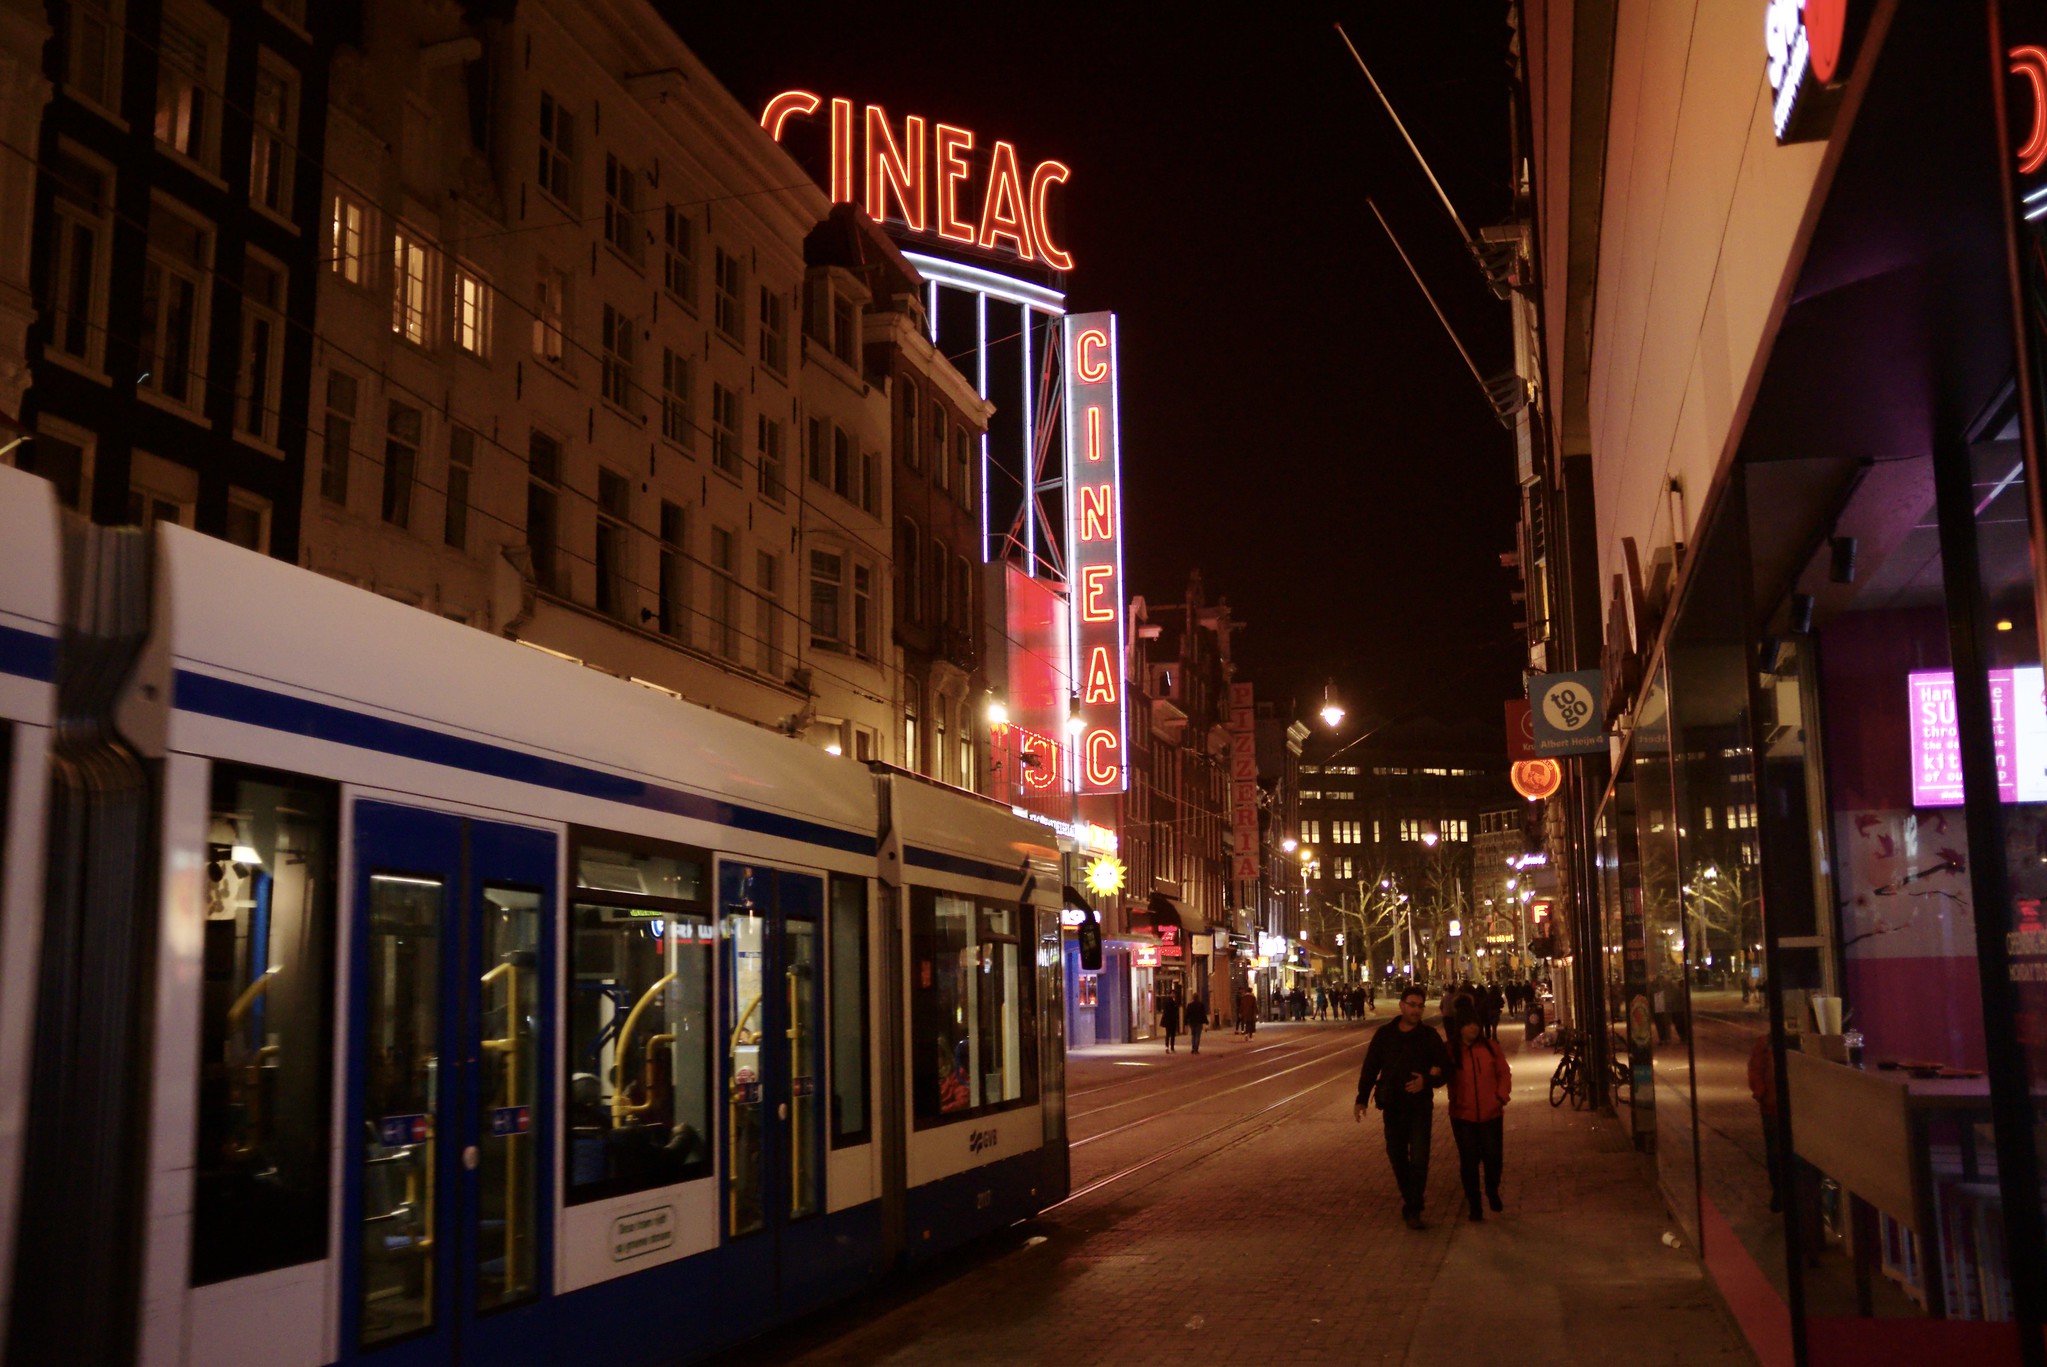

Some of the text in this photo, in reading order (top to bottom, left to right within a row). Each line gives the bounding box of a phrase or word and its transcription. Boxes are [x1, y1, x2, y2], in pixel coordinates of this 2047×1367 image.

[1077, 330, 1117, 786] CINEAC
[1551, 689, 1576, 709] to
[1561, 701, 1588, 727] go
[1540, 736, 1595, 749] Albert Heijn
[1233, 686, 1256, 876] PIZZERIA
